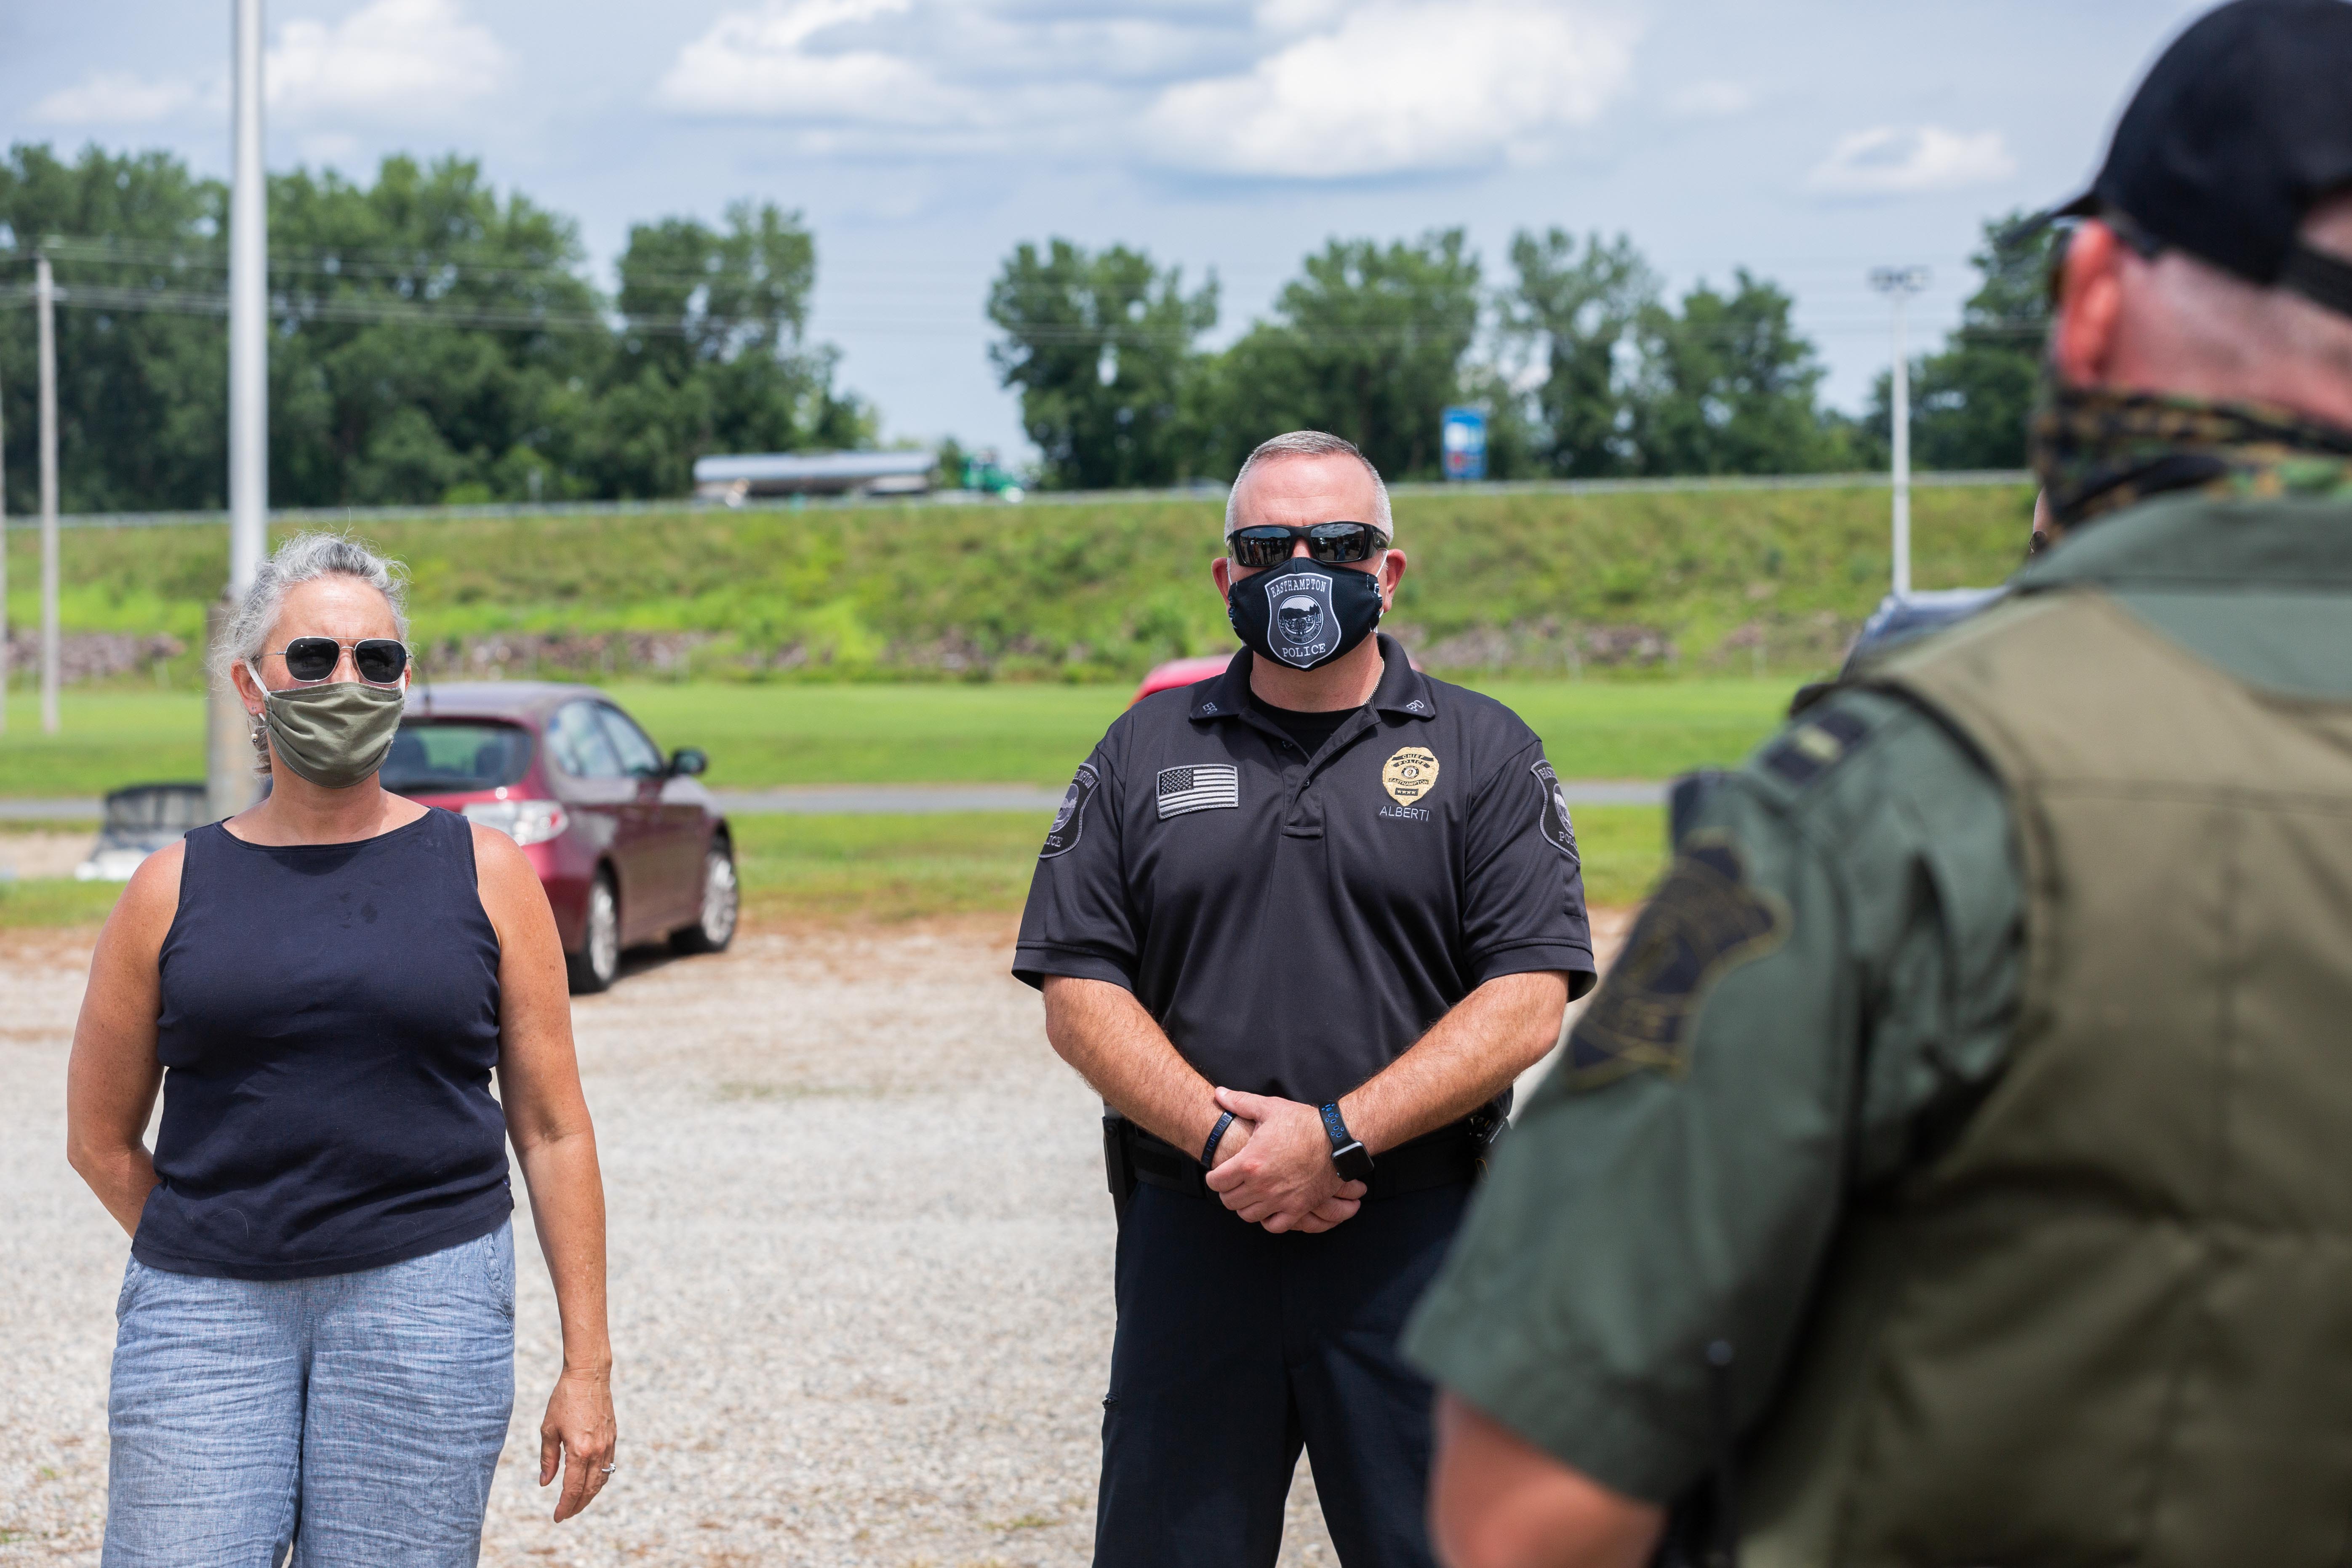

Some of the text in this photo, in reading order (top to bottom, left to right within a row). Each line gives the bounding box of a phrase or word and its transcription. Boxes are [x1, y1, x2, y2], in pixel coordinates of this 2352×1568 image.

[1270, 579, 1326, 598] EASTHAMPTON
[1282, 643, 1325, 657] POLICE
[1203, 702, 1217, 714] EPD
[1406, 700, 1424, 712] EPD
[1389, 778, 1428, 786] EASTHAMPTON
[1379, 806, 1429, 821] ALBERTI
[1206, 1115, 1231, 1152] FOREVER
